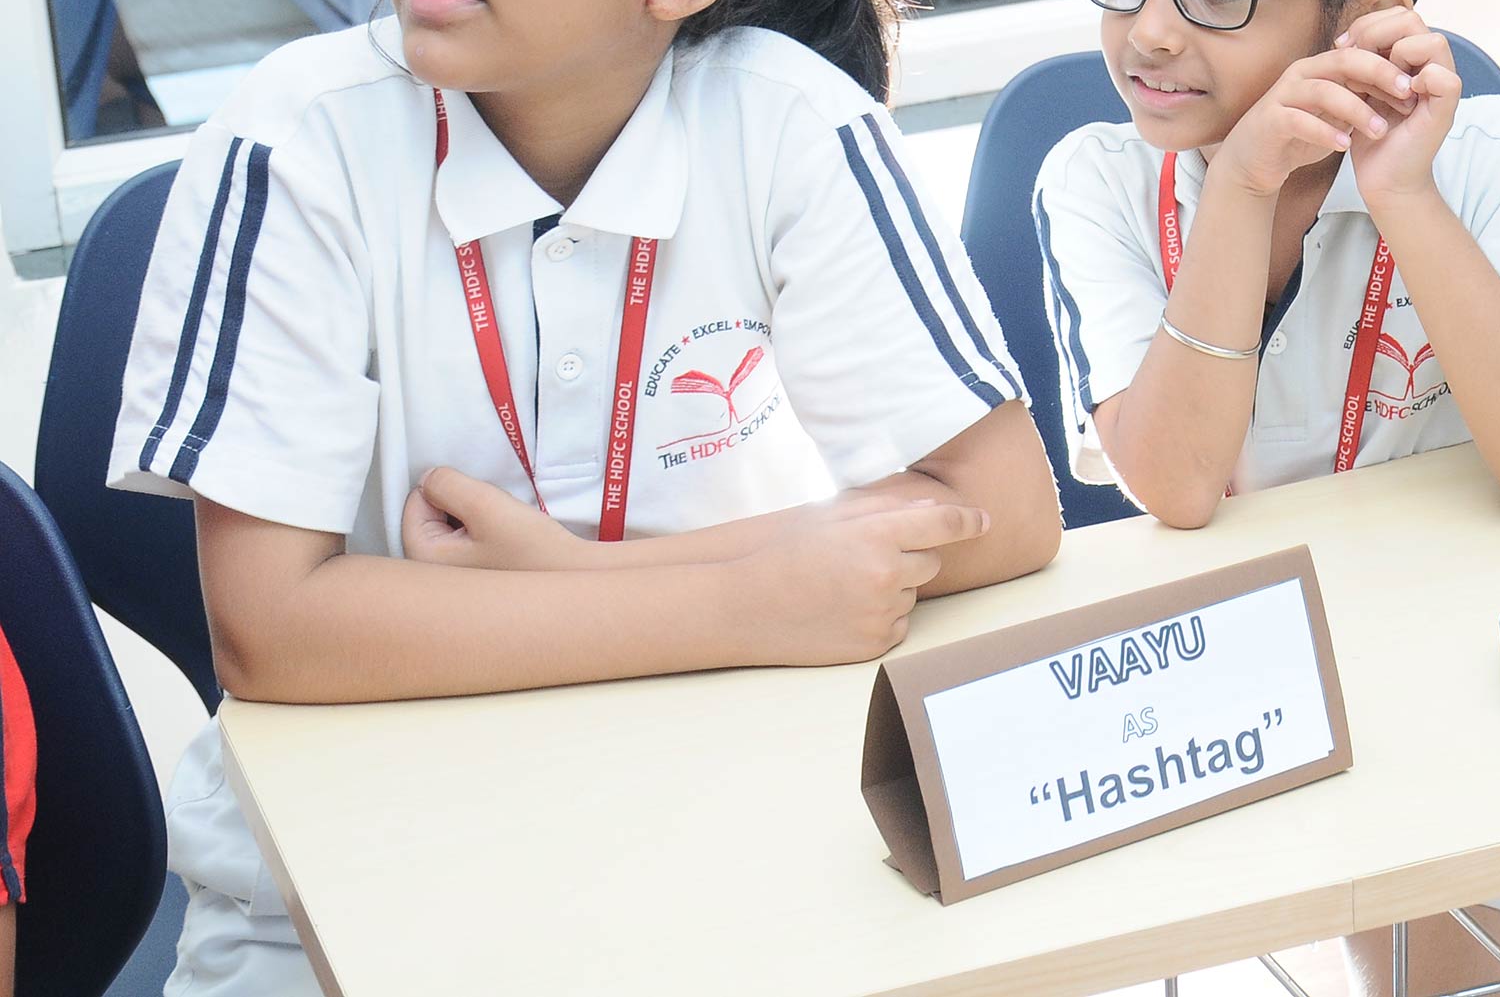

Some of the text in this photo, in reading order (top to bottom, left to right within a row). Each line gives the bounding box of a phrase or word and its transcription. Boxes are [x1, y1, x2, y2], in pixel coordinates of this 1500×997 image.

[1164, 209, 1180, 264] SCHOOL
[462, 259, 483, 299] HDFC
[630, 276, 647, 306] THE
[1368, 265, 1386, 301] HDFC
[472, 301, 489, 332] THE
[1361, 304, 1378, 329] THE
[645, 319, 772, 397] EDUCATE EXCEL EMPO
[1342, 395, 1360, 445] SCHOOL
[1374, 400, 1411, 420] HDFC
[606, 380, 633, 511] THE HDFC SCHOOL
[658, 451, 688, 469] THE
[690, 432, 738, 460] HDFC
[1049, 616, 1207, 699] VAAYU
[1121, 707, 1159, 743] AS
[1029, 708, 1283, 822] “Hashtag”
